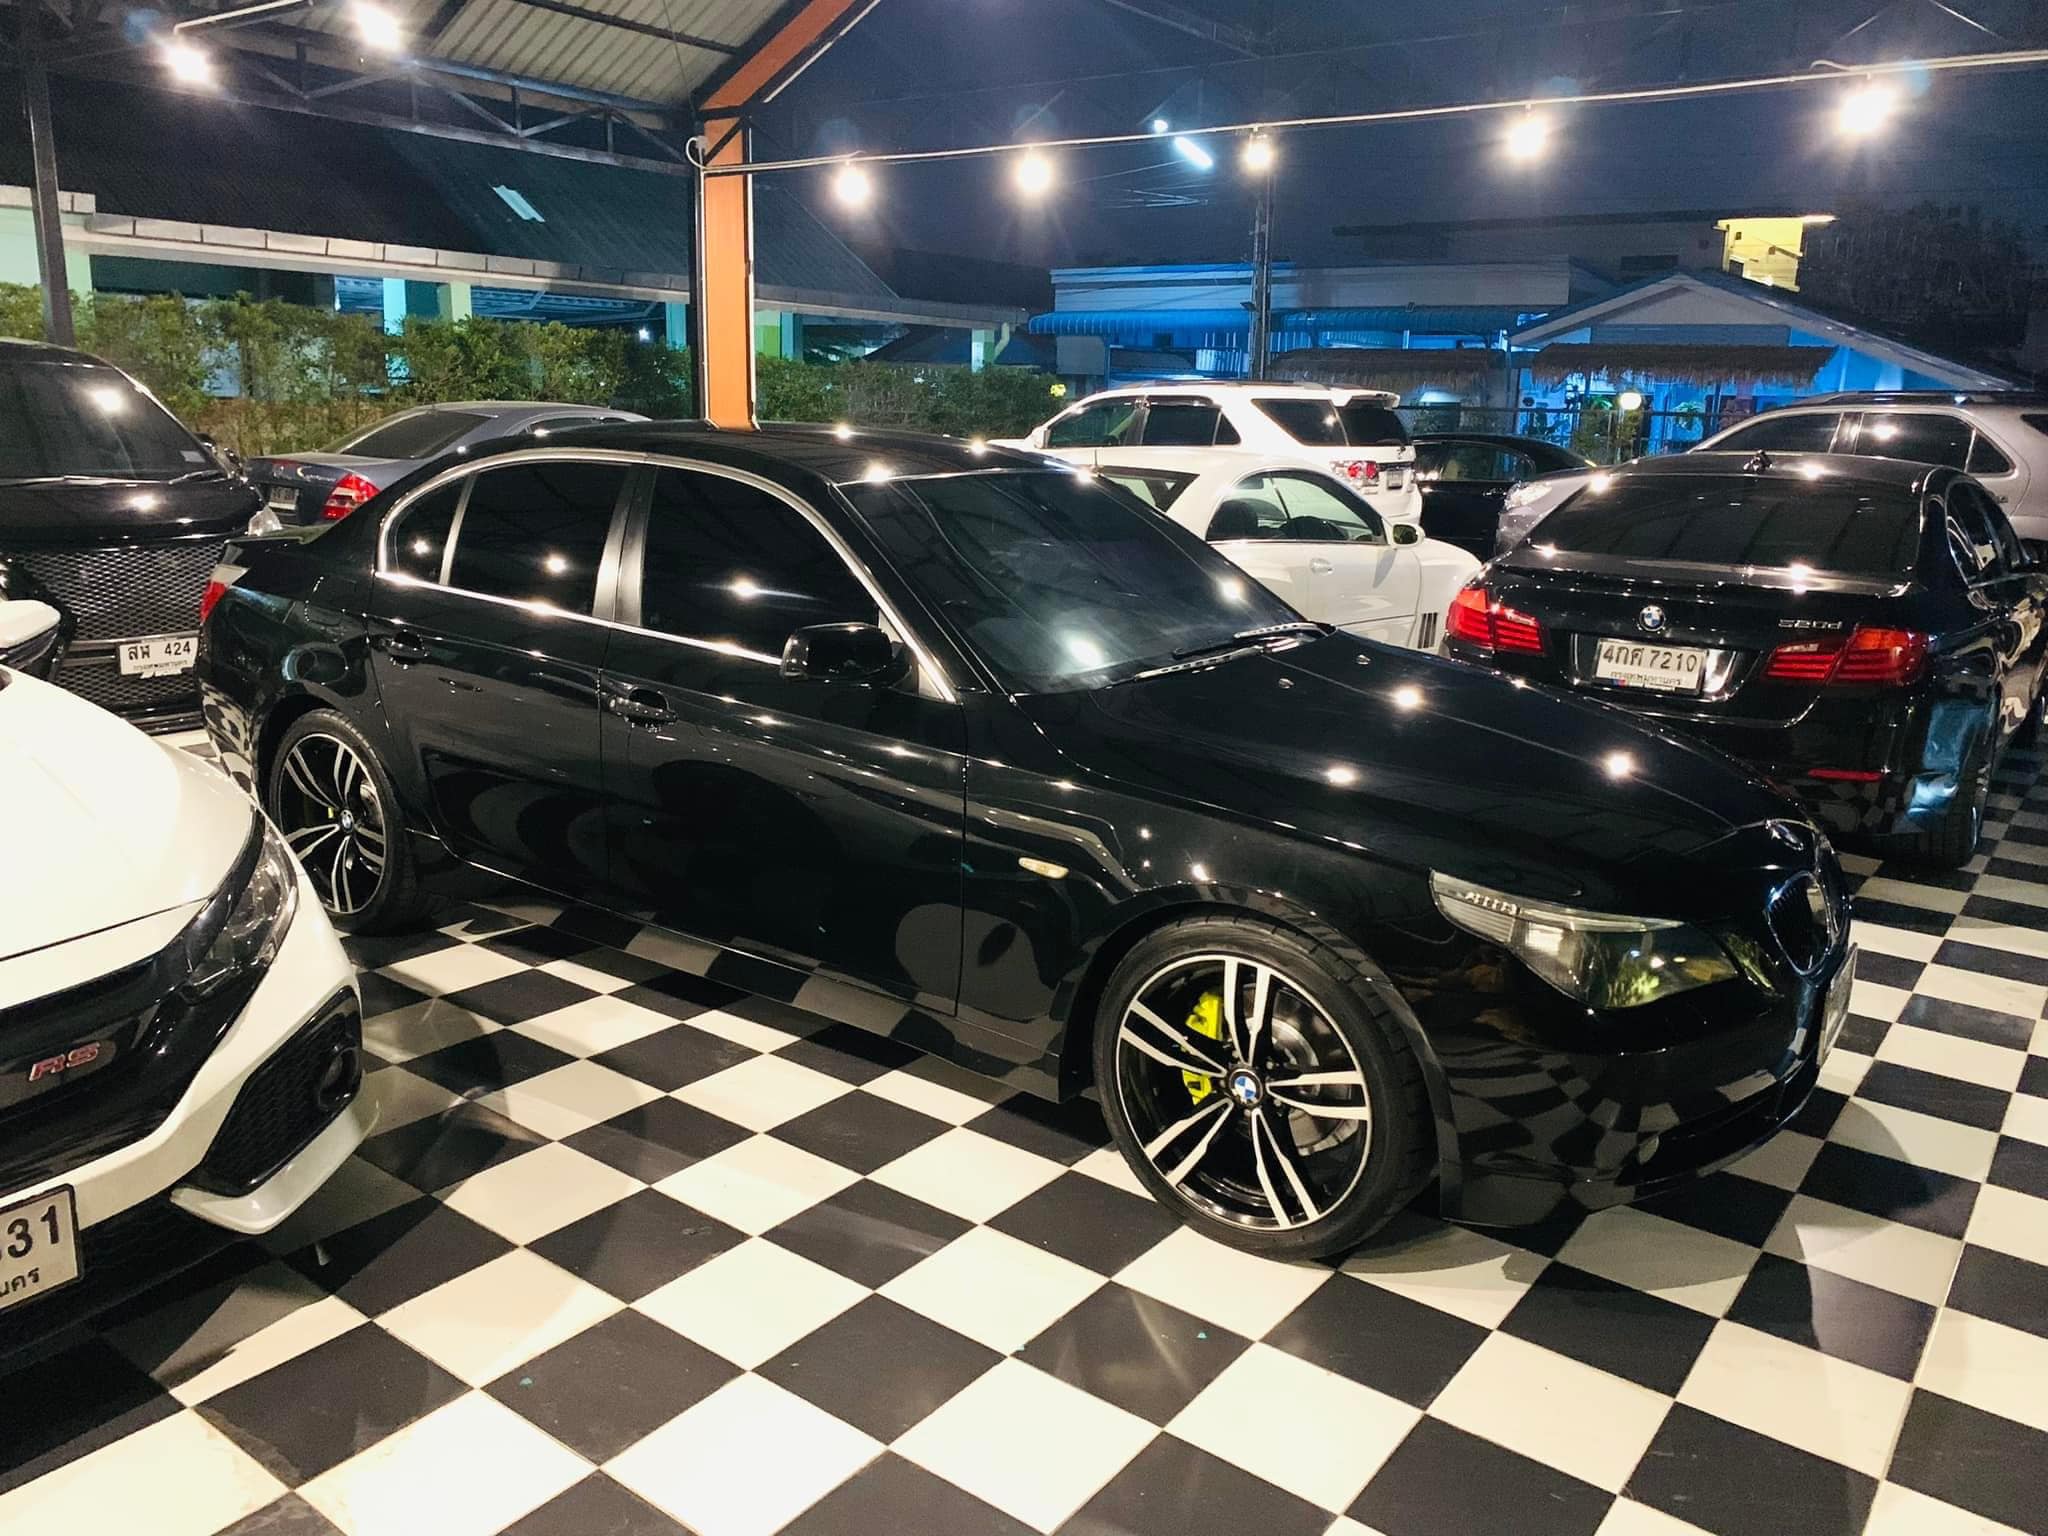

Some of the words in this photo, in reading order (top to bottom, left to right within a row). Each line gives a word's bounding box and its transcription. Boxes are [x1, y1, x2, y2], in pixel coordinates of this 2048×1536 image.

[1778, 619, 1842, 630] 520d
[164, 641, 190, 656] 424
[1650, 650, 1698, 672] 7210
[29, 1042, 100, 1081] RS
[0, 1205, 59, 1262] 31
